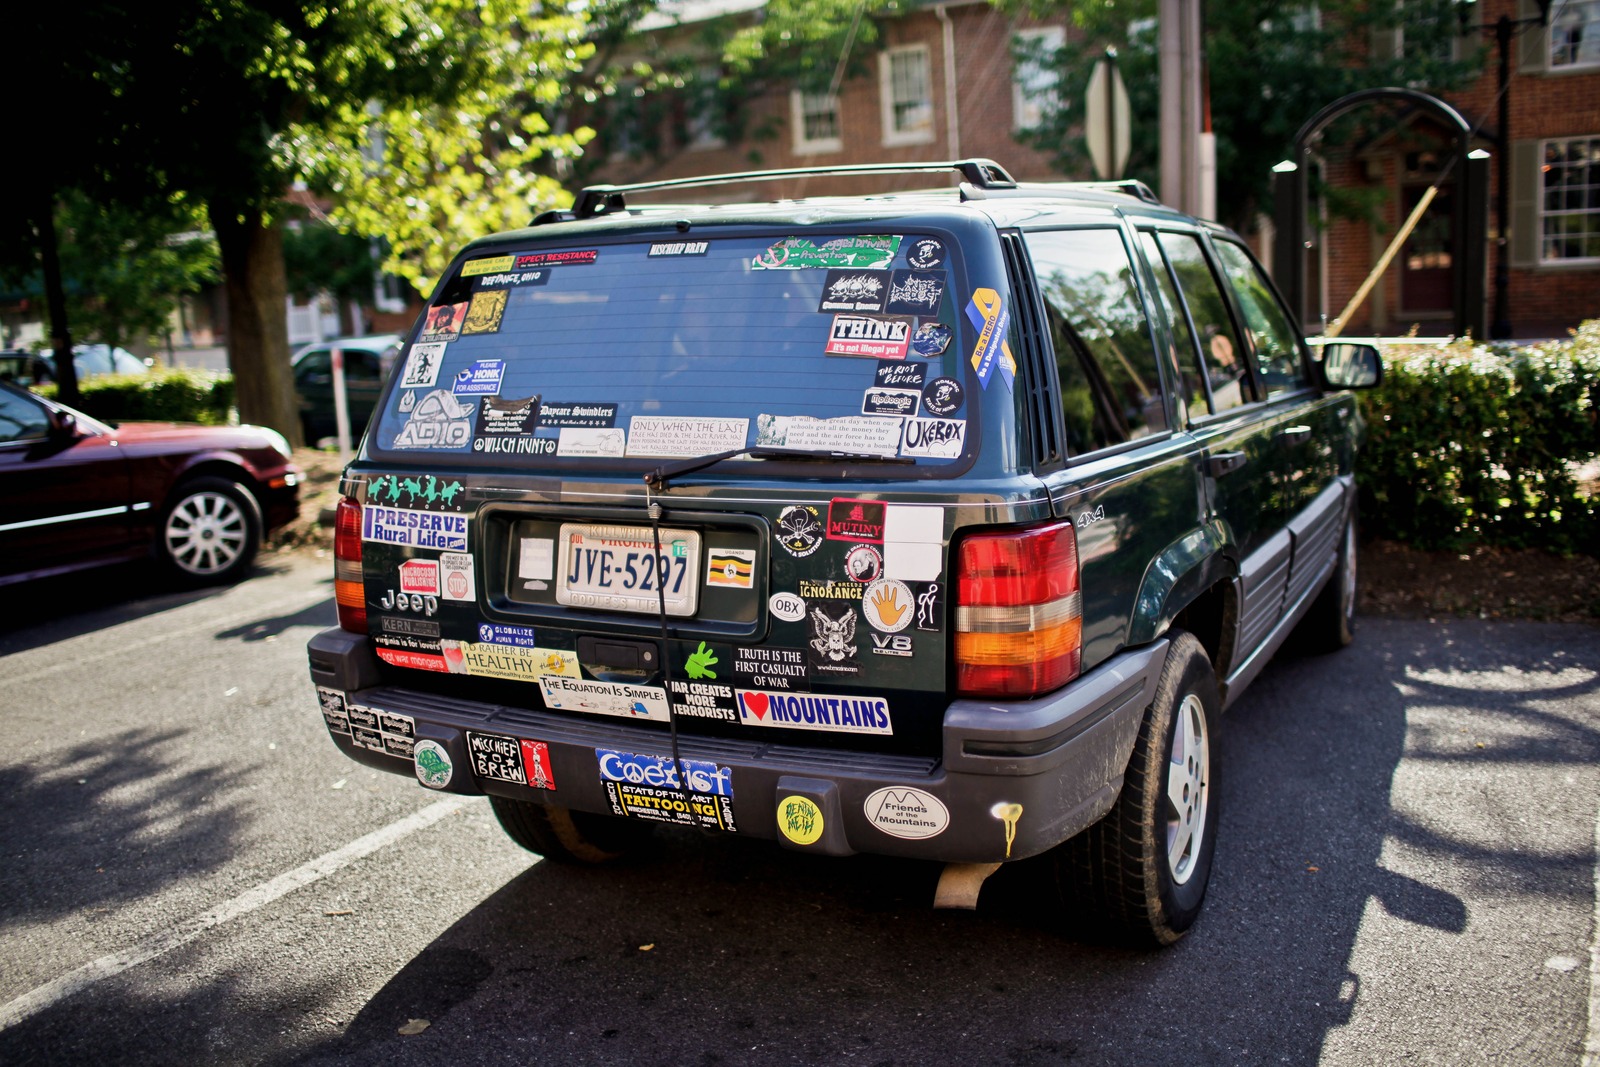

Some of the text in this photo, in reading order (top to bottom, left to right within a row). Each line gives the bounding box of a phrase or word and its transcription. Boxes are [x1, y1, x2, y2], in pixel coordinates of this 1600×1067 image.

[516, 250, 597, 264] EXPECT RESISTANCE
[481, 271, 541, 286] DEFIANCE, OHIO
[836, 319, 908, 340] THINK
[975, 346, 984, 357] Be
[983, 315, 996, 337] HERO
[833, 343, 899, 355] it's not illegal yet
[978, 367, 987, 377] Be
[985, 327, 1002, 361] Designated
[998, 311, 1008, 329] Driver
[474, 369, 500, 379] HONK
[878, 363, 918, 376] THE RIOT
[884, 374, 923, 384] BEFORE
[540, 405, 571, 417] Daycare
[571, 406, 614, 417] Swindlers
[397, 421, 471, 446] ADIO
[633, 421, 745, 434] ONLY WHEN THE LAST
[875, 427, 890, 435] they
[905, 420, 964, 449] UKEBOX
[484, 437, 547, 455] WITCH HUNT
[374, 508, 466, 534] PRESERVE
[373, 524, 447, 549] Rural Life
[831, 521, 883, 537] MUTINY
[797, 536, 823, 558] SOLUTION
[402, 566, 436, 578] MICROCOSM
[568, 547, 688, 594] JVE-5297
[403, 577, 436, 587] PUBLISHING
[800, 585, 863, 600] IGNORANCE
[380, 589, 439, 617] Jeep
[775, 599, 800, 615] OBX
[383, 618, 412, 632] KERN
[494, 626, 533, 637] GLOBALIZE
[514, 637, 534, 646] RIGHTS
[870, 633, 912, 651] V8
[479, 644, 517, 656] RATHER
[519, 648, 532, 658] BE
[737, 647, 802, 663] TRUTH IS THE
[381, 652, 444, 669] not war mongers
[465, 653, 533, 673] HEALTHY
[470, 668, 535, 680] www.ShopHealthy.com
[734, 660, 760, 674] FIRST
[761, 662, 807, 677] CASUALTY
[753, 675, 790, 689] OF WAR
[689, 683, 733, 698] CREATES
[684, 694, 717, 708] MORE
[737, 692, 889, 729] I MOUNTAINS
[477, 760, 523, 781] BREW
[621, 784, 713, 805] STATE OF ART
[885, 802, 928, 814] Friends
[879, 815, 937, 828] Mountains
